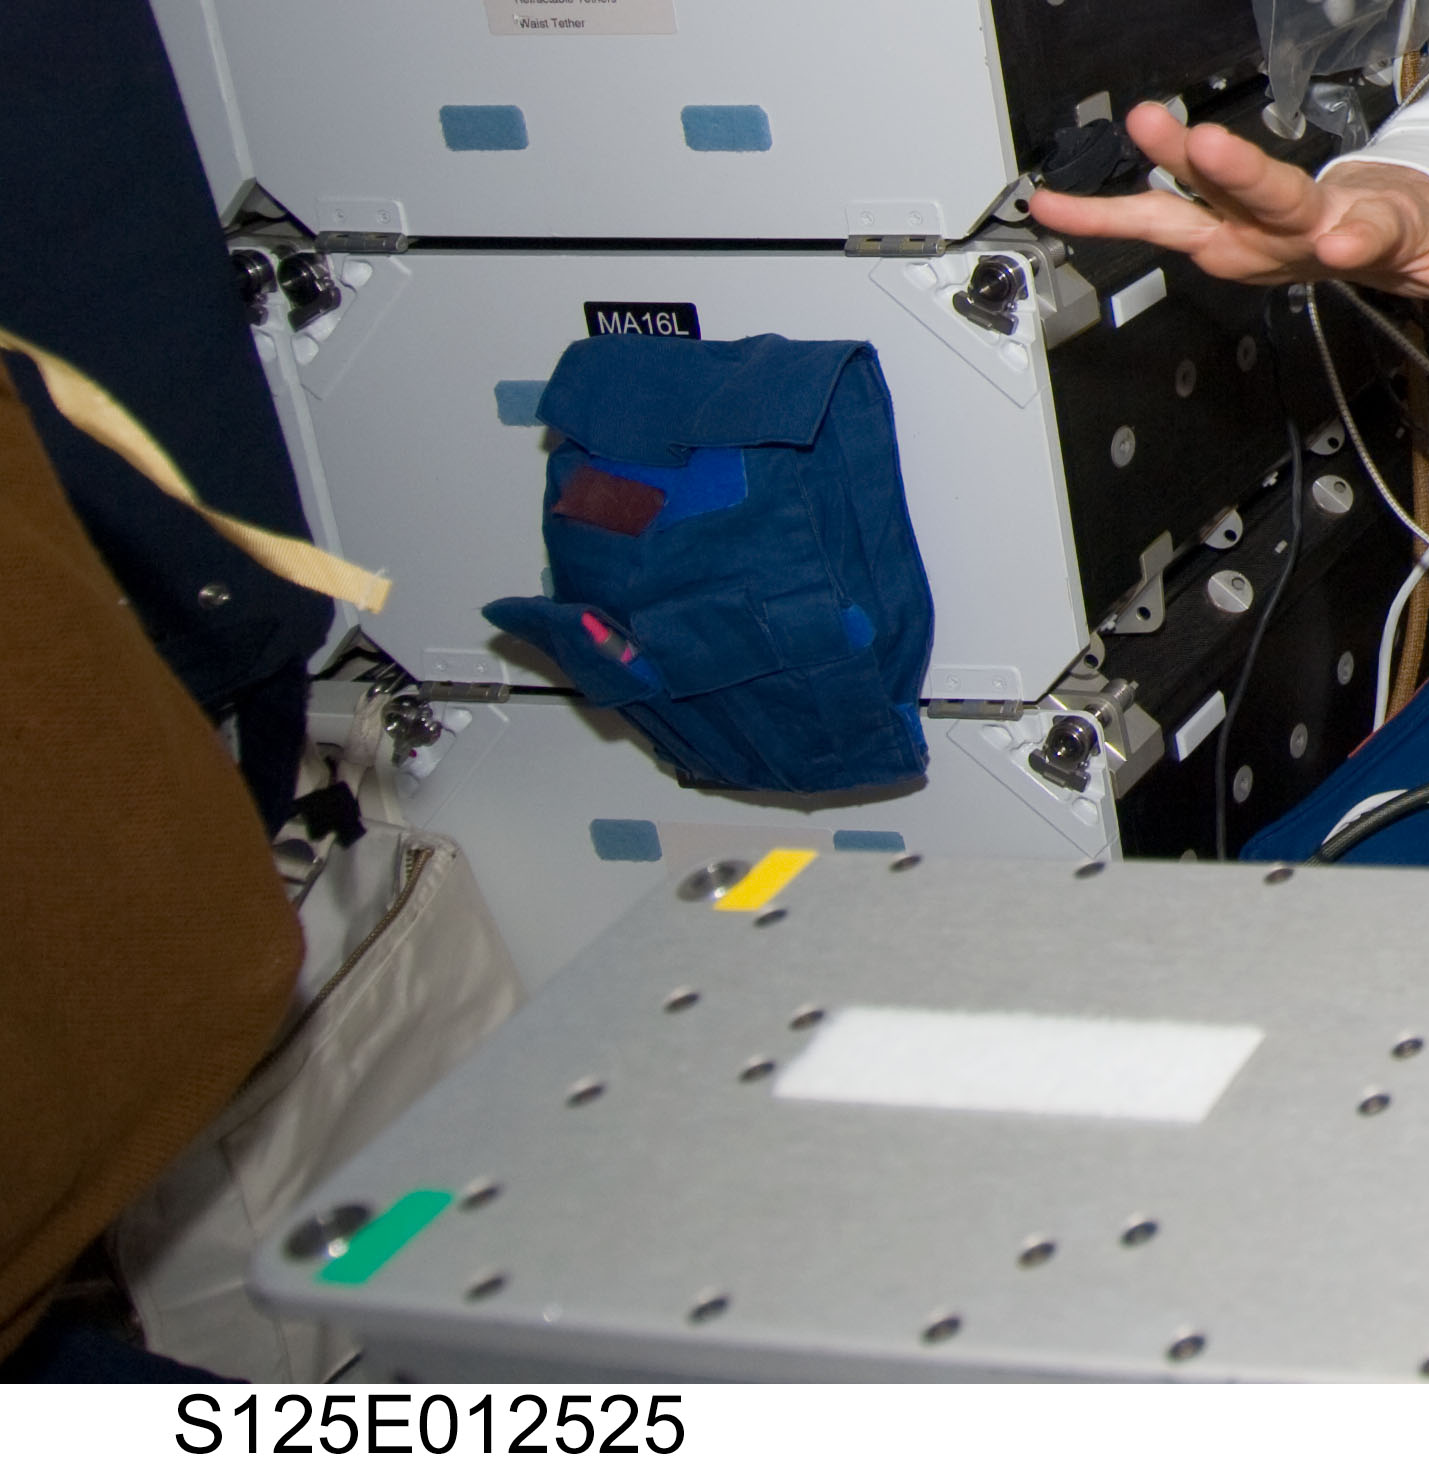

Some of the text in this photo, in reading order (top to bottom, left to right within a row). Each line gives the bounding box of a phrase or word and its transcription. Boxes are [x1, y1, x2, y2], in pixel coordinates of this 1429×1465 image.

[519, 17, 585, 30] Waist Tether
[596, 309, 691, 338] MA16L
